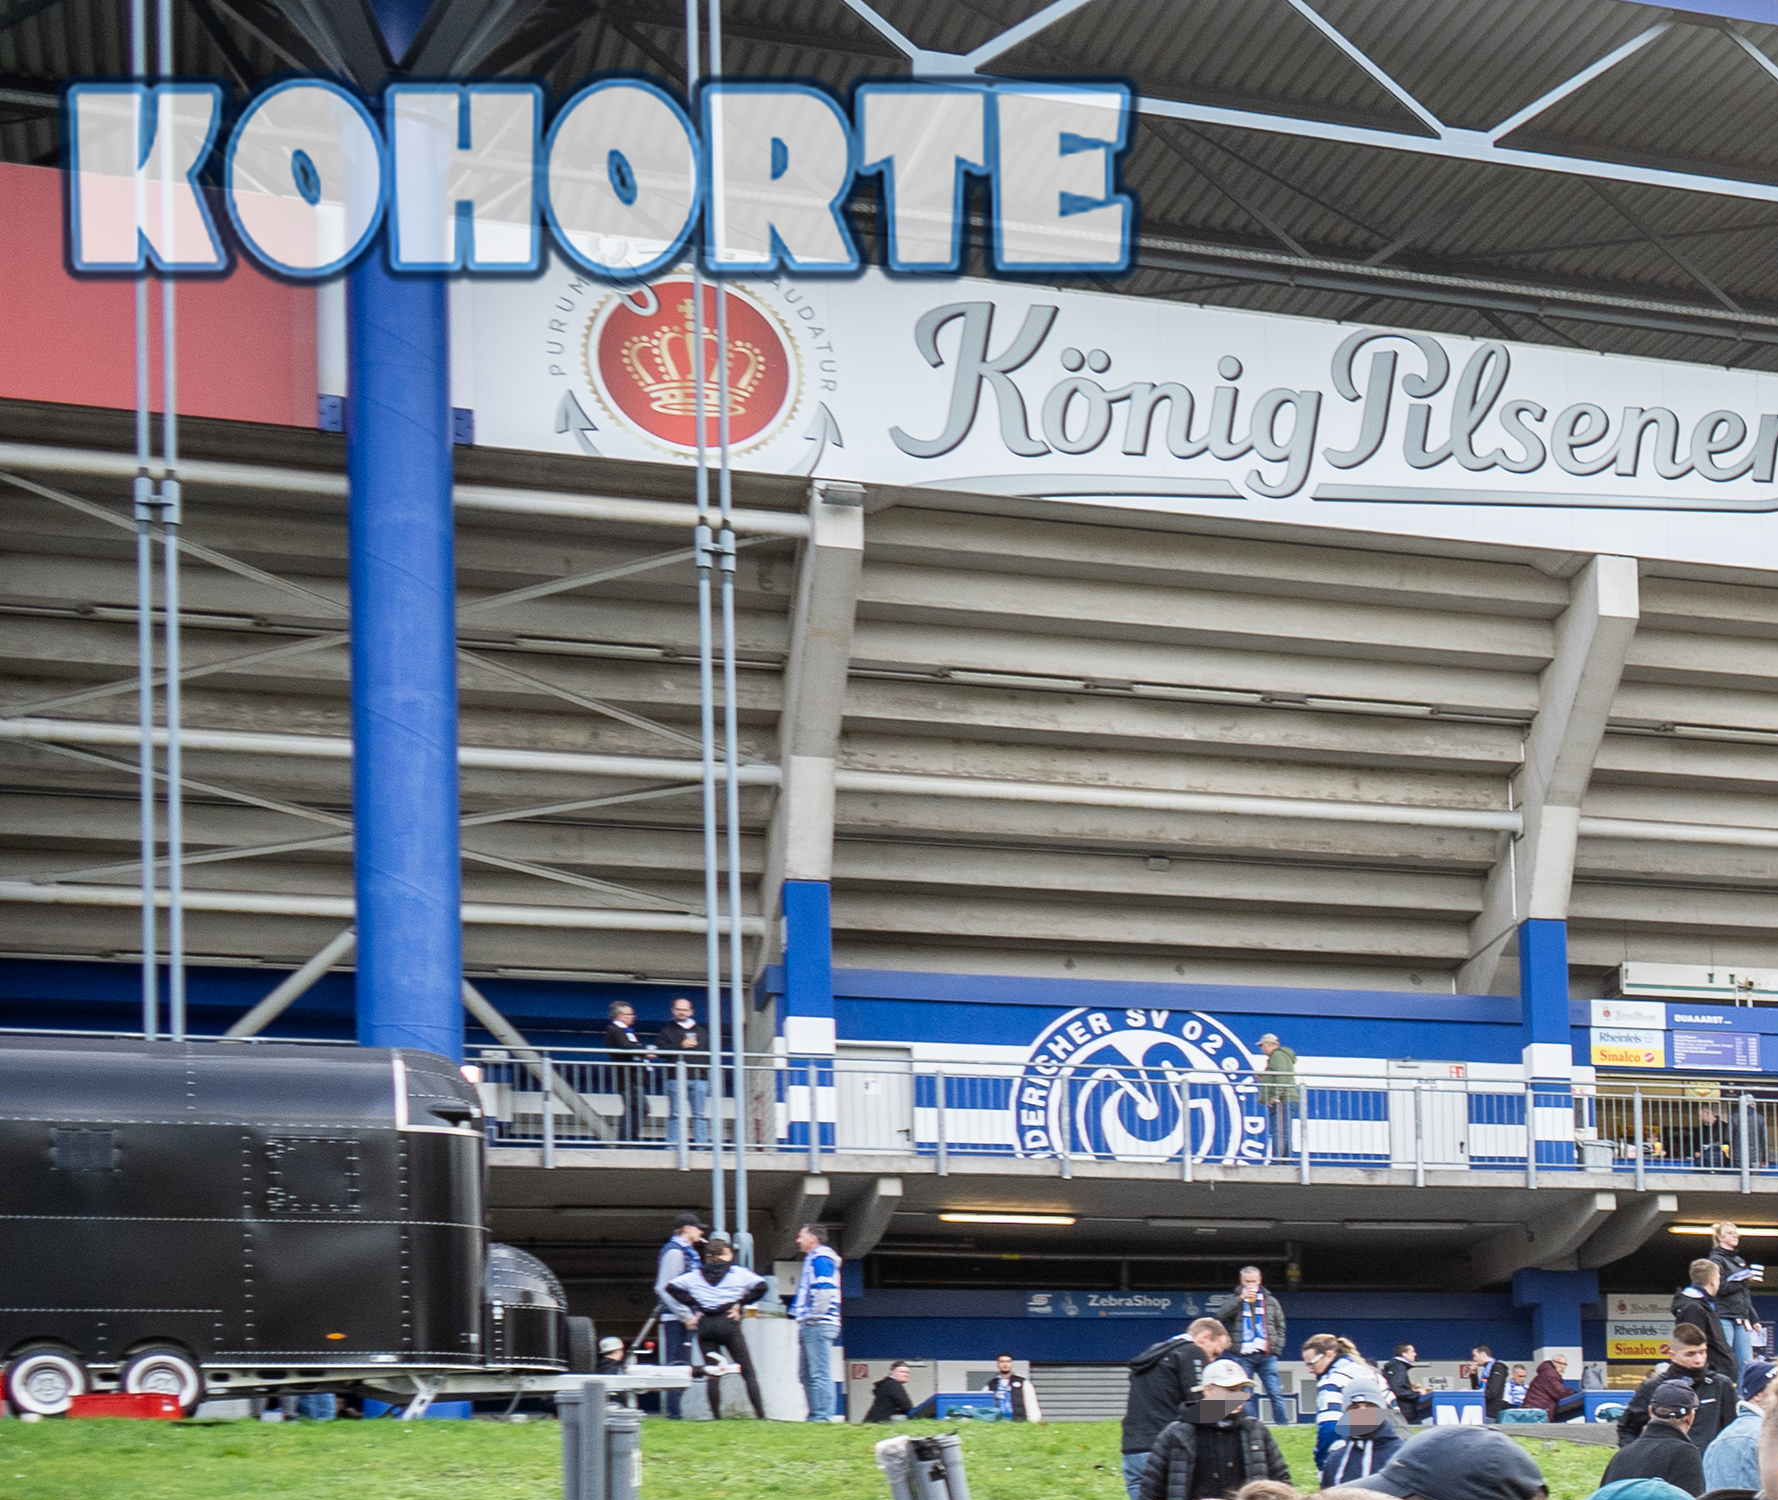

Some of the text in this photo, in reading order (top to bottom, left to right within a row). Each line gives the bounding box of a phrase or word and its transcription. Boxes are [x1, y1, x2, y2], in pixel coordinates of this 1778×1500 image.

[752, 268, 838, 392] AUDATUR
[890, 300, 1323, 498] König
[1126, 1009, 1170, 1029] SV
[1182, 1020, 1224, 1055] 02
[1599, 1031, 1642, 1044] Rheinfels
[1599, 1049, 1641, 1063] Sinalco
[1087, 1294, 1172, 1310] ZebraShop
[1614, 1324, 1658, 1337] Rheinfels
[1614, 1341, 1657, 1355] Sinalco
